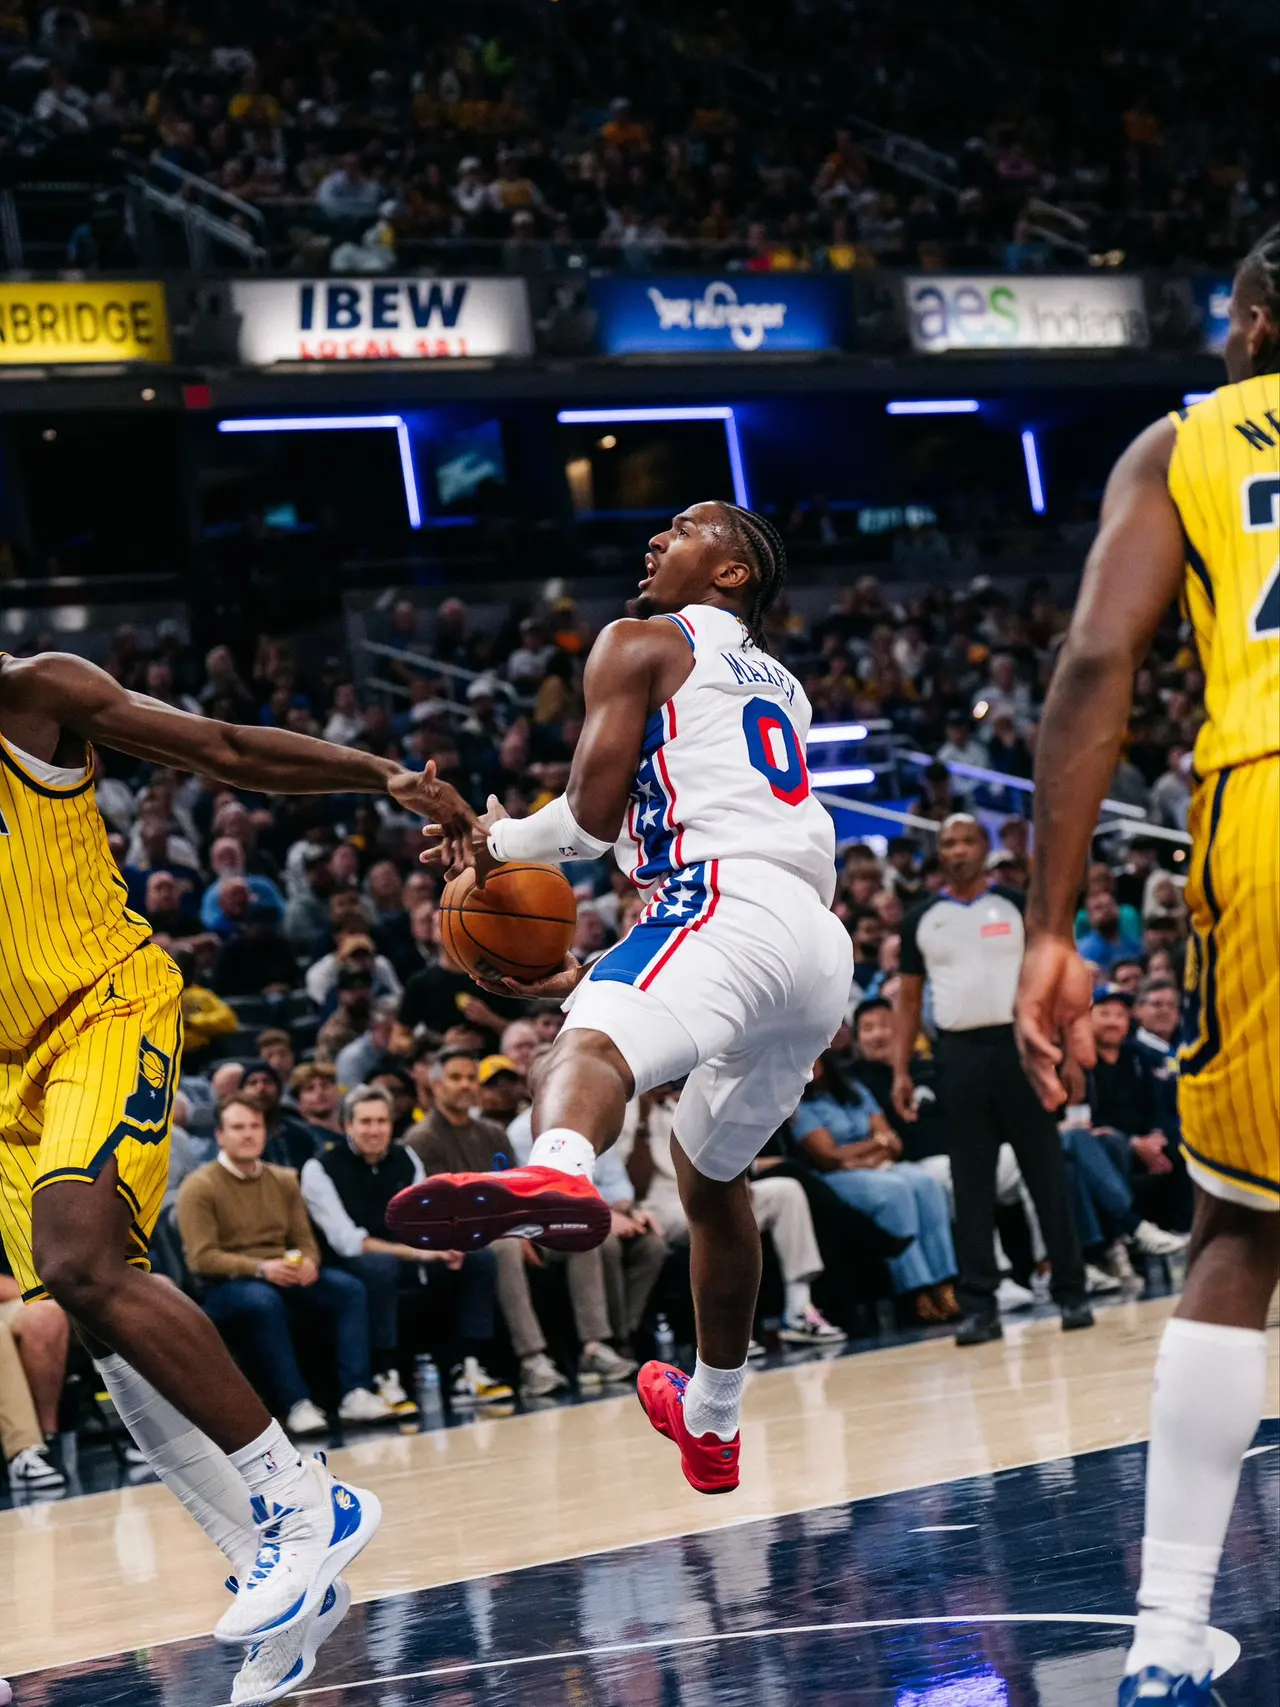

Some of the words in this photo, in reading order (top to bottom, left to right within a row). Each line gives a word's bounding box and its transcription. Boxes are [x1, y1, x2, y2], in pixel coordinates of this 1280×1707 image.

[0, 300, 153, 344] BRIDGE
[300, 282, 470, 330] IBEW
[910, 284, 1020, 342] aes
[720, 652, 796, 707] MAXEY
[742, 696, 810, 807] 0
